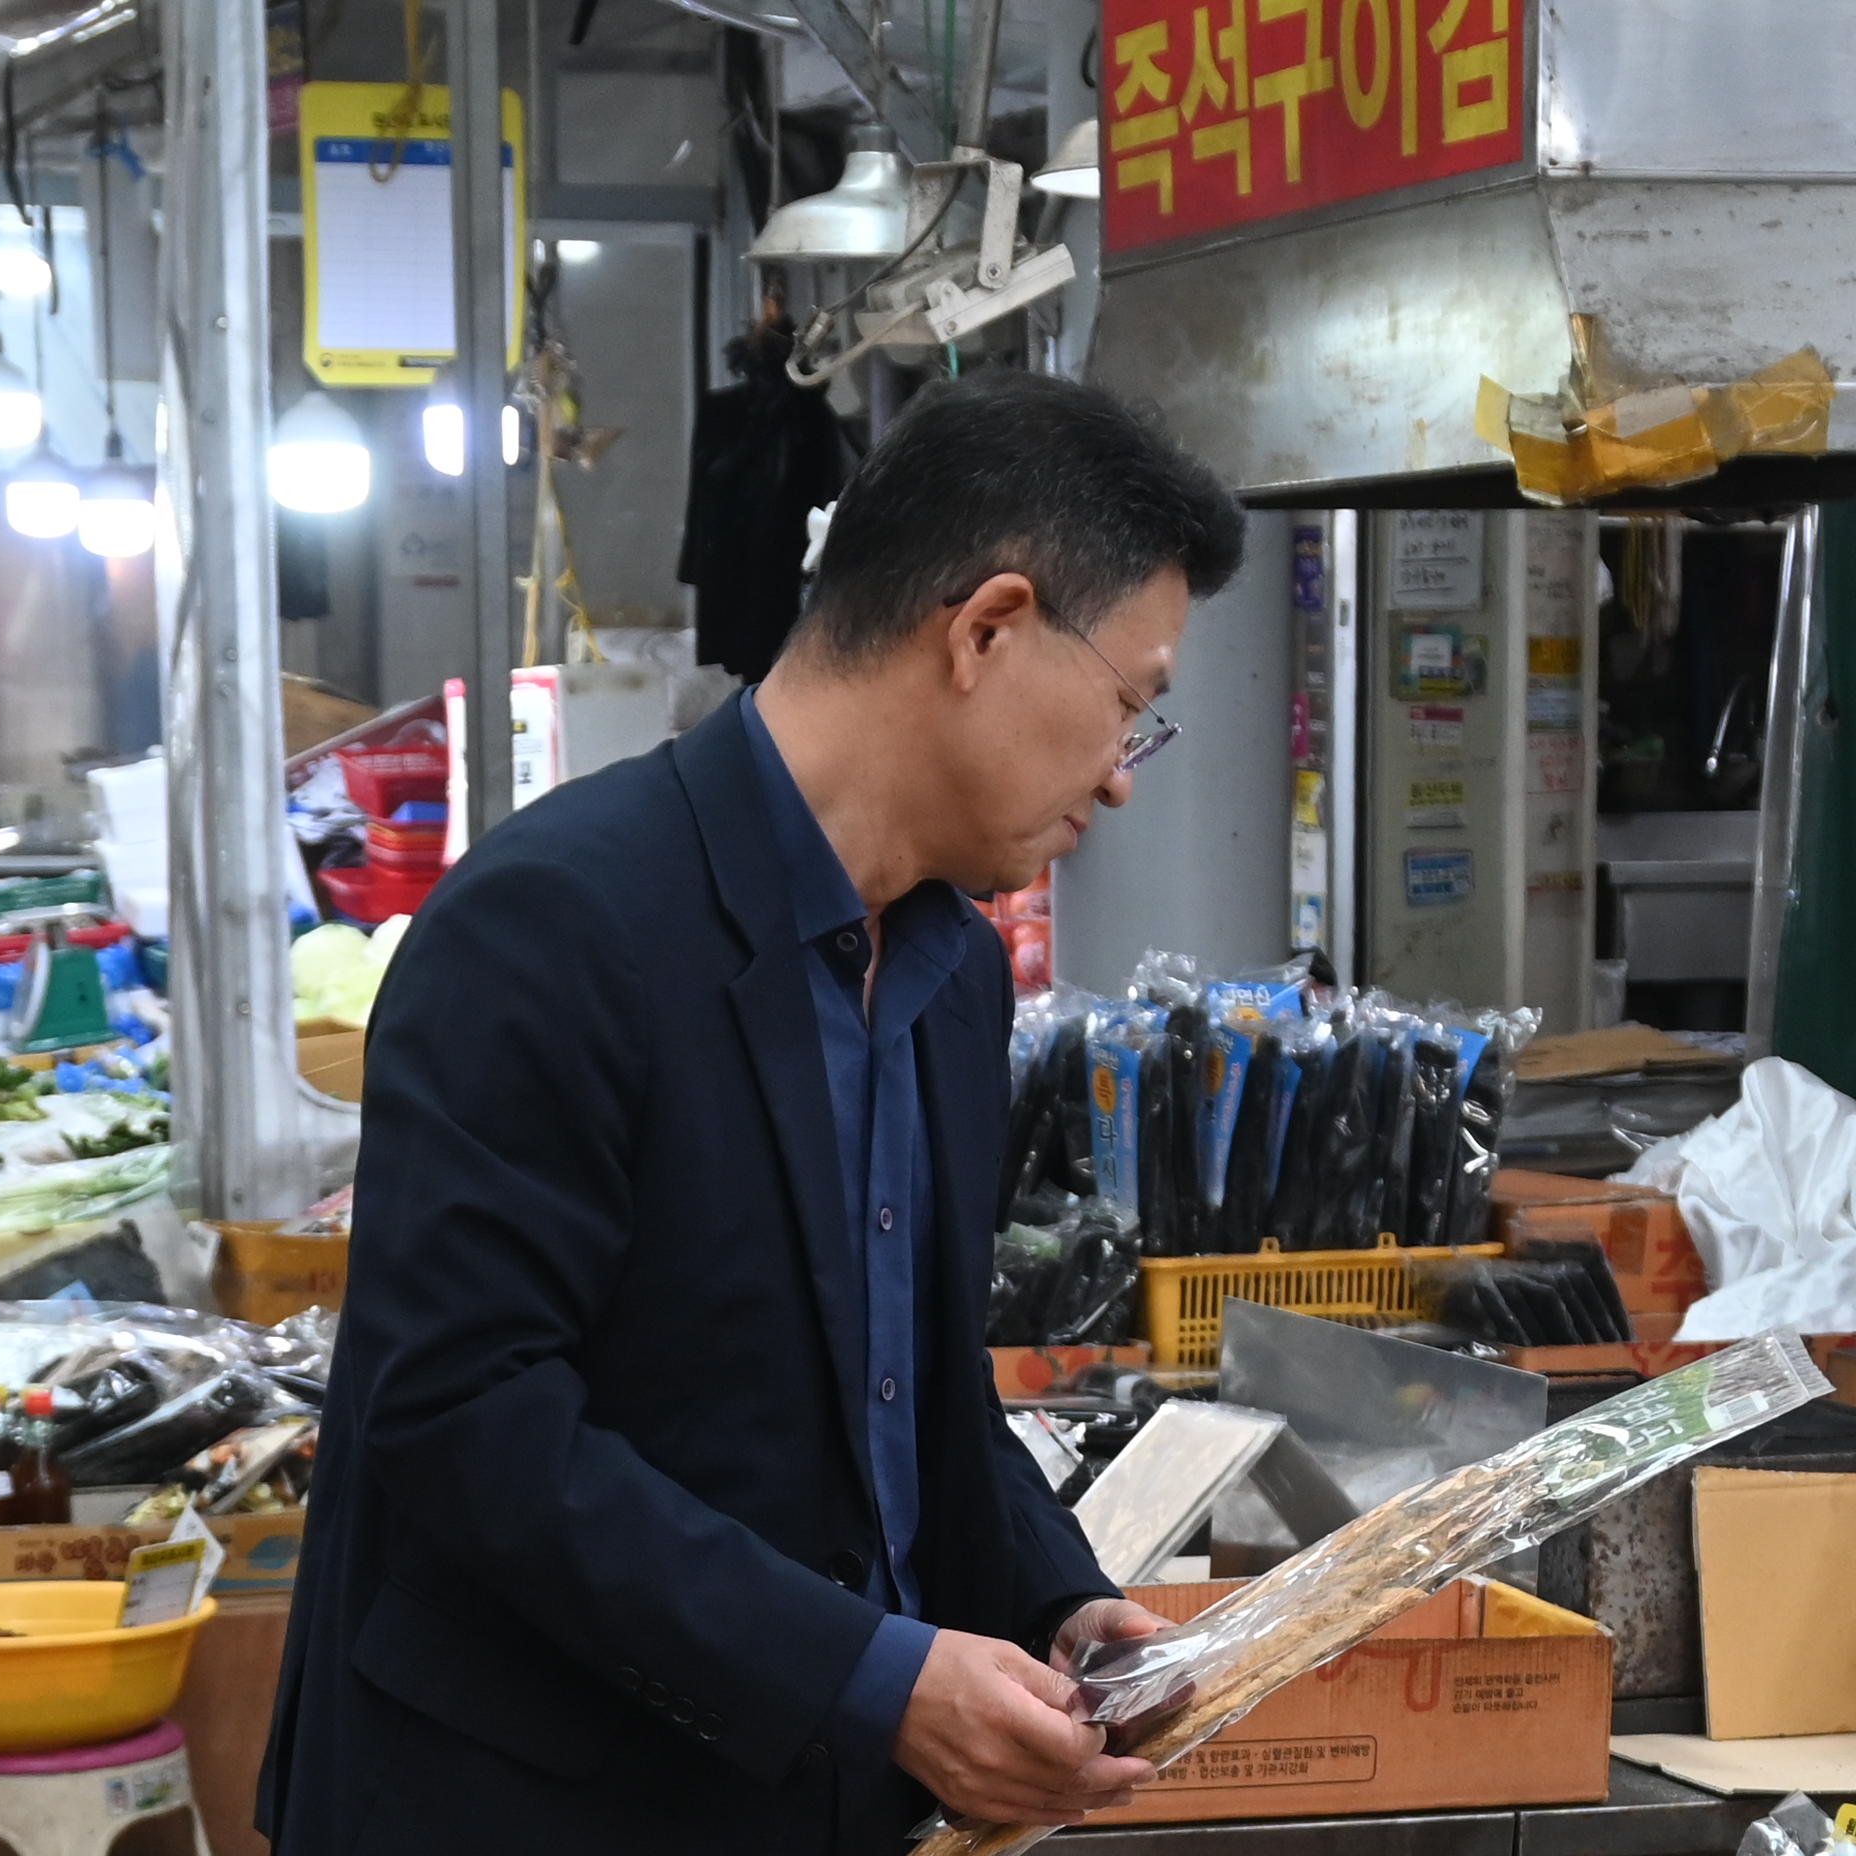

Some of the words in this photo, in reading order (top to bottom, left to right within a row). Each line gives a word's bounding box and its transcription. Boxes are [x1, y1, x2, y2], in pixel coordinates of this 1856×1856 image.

[1109, 0, 1509, 216] 즉석구이김
[1454, 1688, 1473, 1700] 감기
[1475, 1688, 1502, 1700] 예방에
[1453, 1701, 1480, 1713] 손발이
[1196, 1748, 1206, 1764] 및
[1316, 1745, 1327, 1760] 및
[1244, 1764, 1254, 1778] 및
